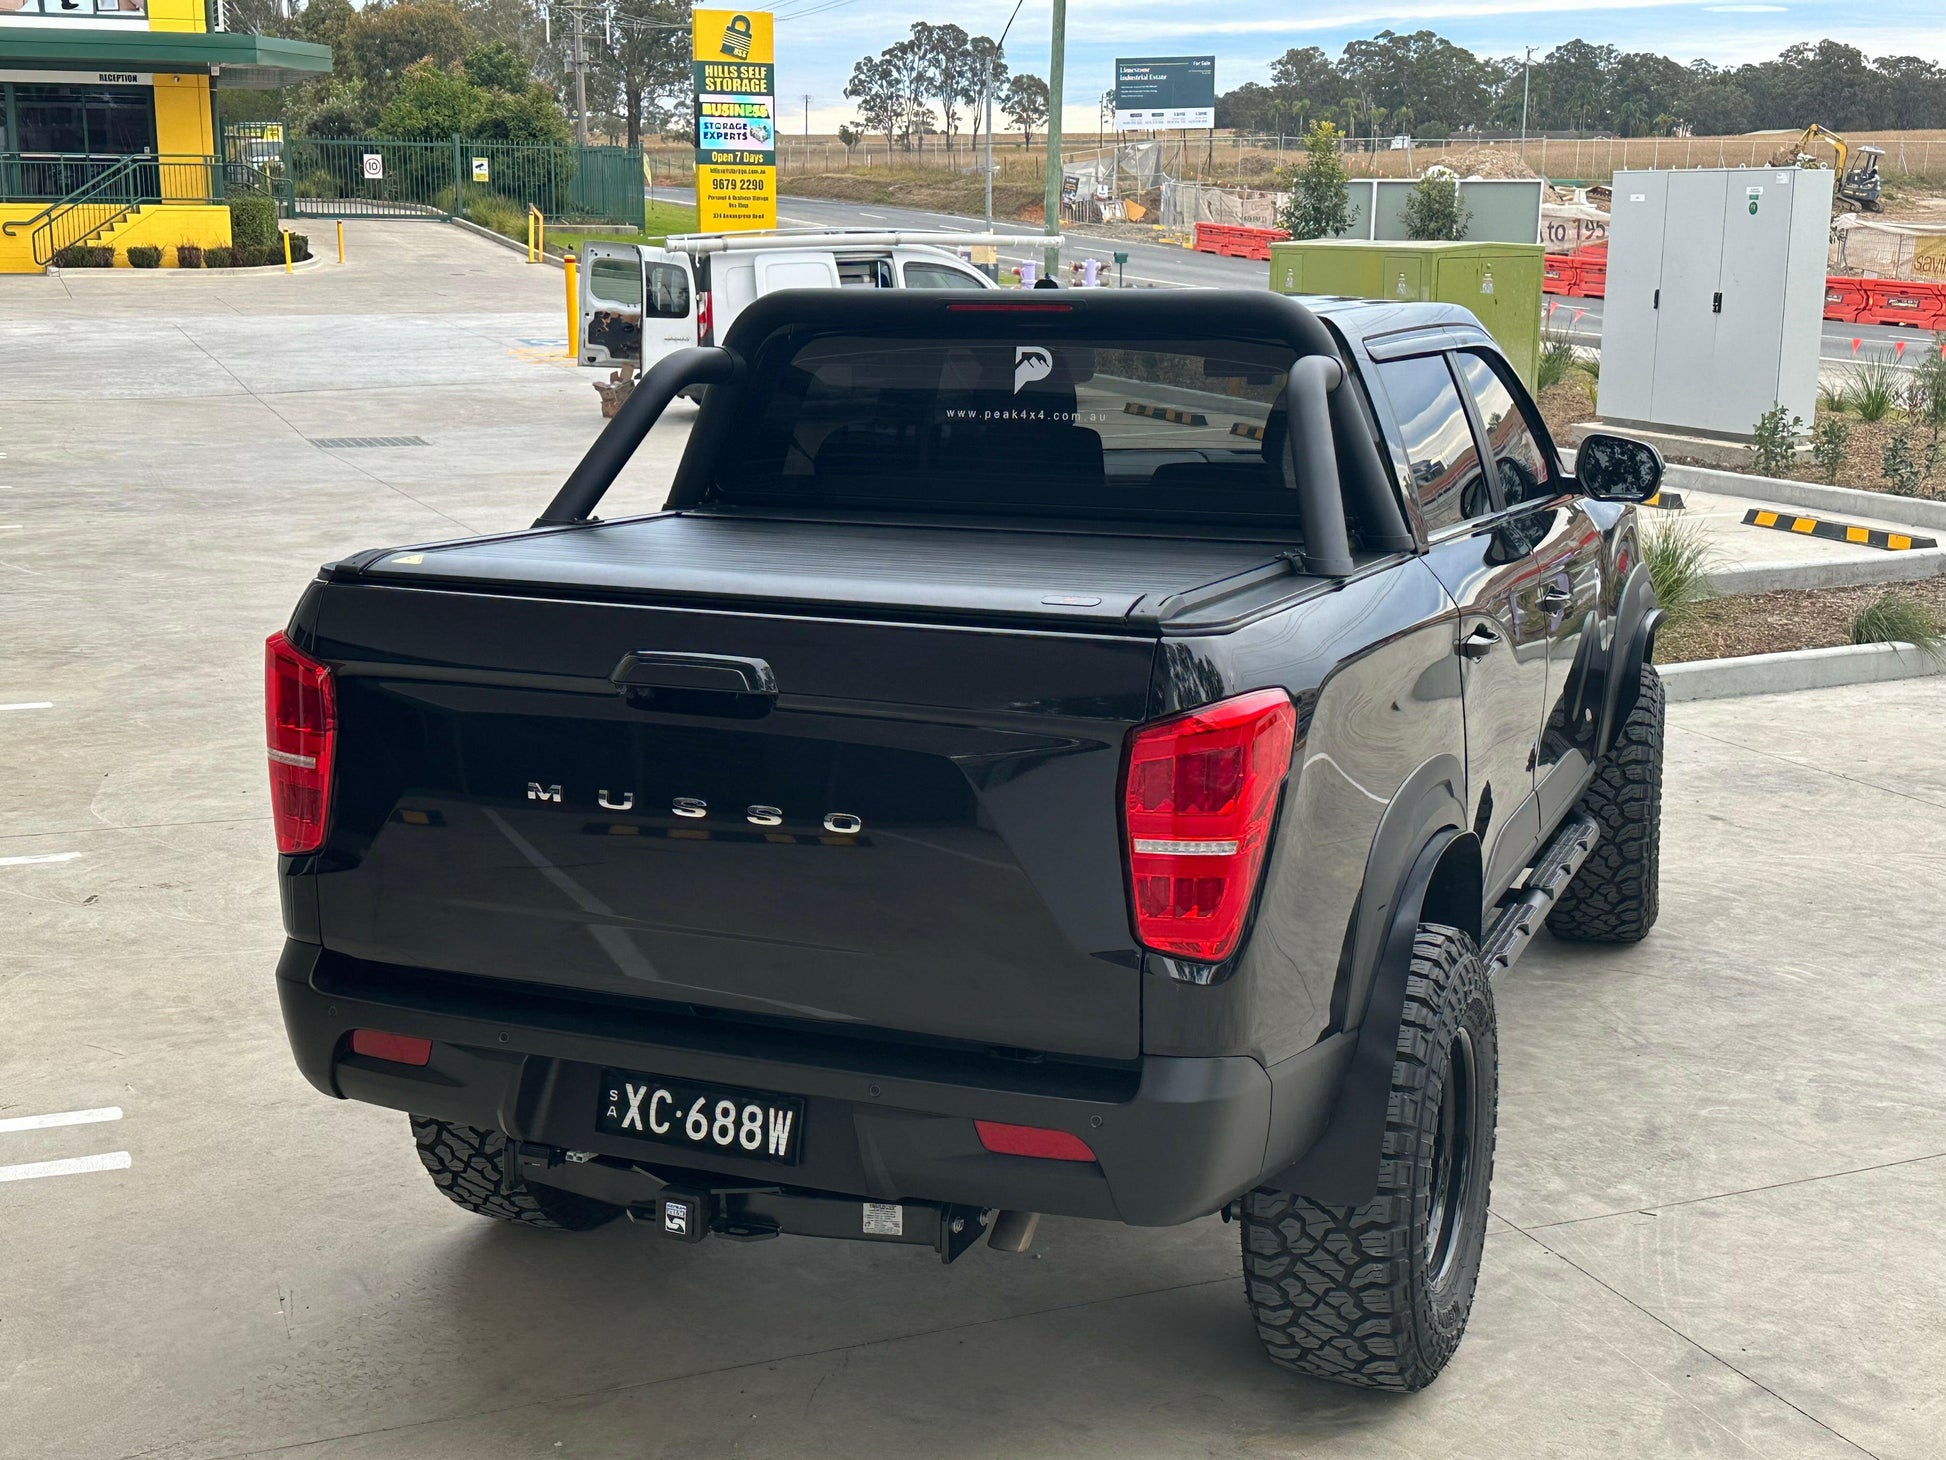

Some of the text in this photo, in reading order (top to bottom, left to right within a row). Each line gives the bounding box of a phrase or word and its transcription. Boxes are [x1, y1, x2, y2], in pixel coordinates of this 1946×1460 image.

[99, 74, 138, 82] RECEPTION
[705, 65, 767, 79] HILLS SELF
[1120, 73, 1149, 81] Industrial
[705, 77, 768, 93] STORAGE
[702, 103, 768, 117] BUSINESS
[703, 122, 748, 130] STORAGE
[703, 131, 748, 141] EXPERTS
[711, 151, 764, 164] Open 7 Days
[368, 161, 378, 171] 10
[712, 179, 764, 191] 9679 2290
[1547, 220, 1566, 242] to
[946, 409, 1107, 422] www.peak4x4.com.au
[527, 782, 862, 834] MUSSO
